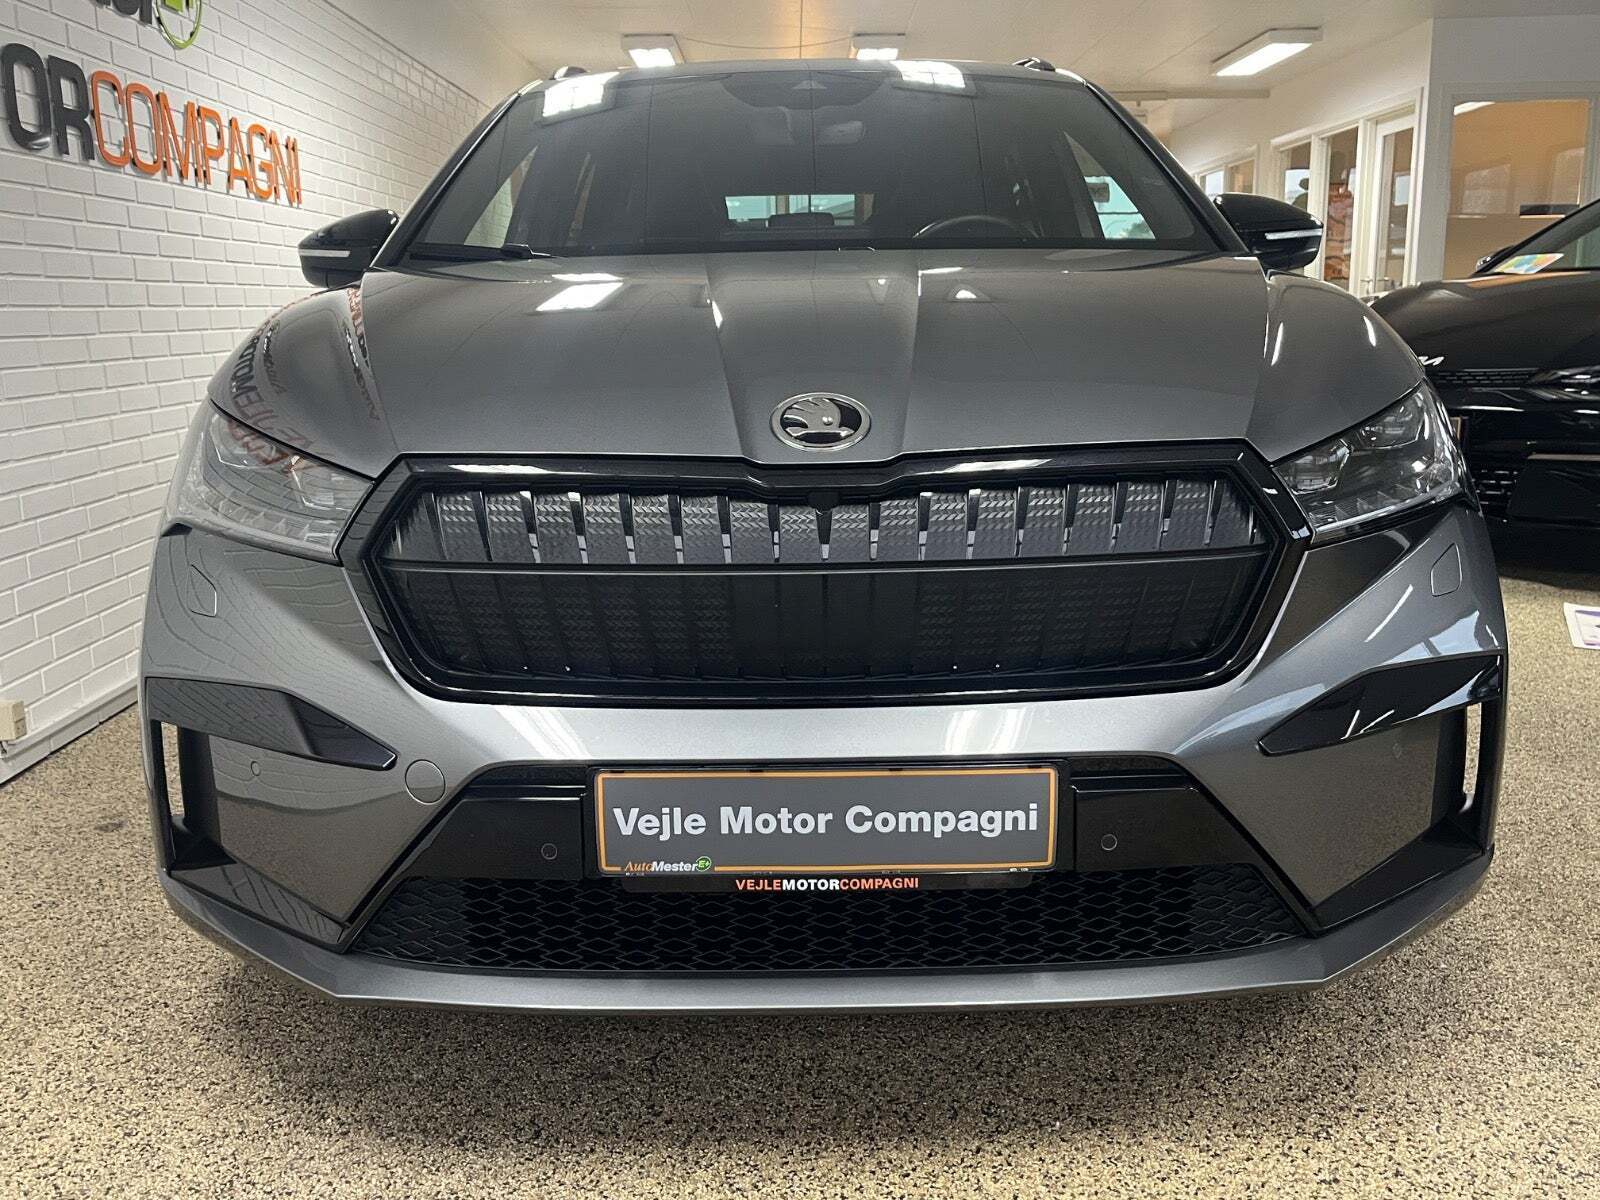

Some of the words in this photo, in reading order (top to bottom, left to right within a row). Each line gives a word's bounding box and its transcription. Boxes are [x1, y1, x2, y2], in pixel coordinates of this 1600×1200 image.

[613, 807, 707, 842] Vejle
[720, 806, 834, 835] Motor
[845, 803, 1038, 838] Compagni
[735, 877, 920, 891] VEJLEMOTORCOMPAGNI
